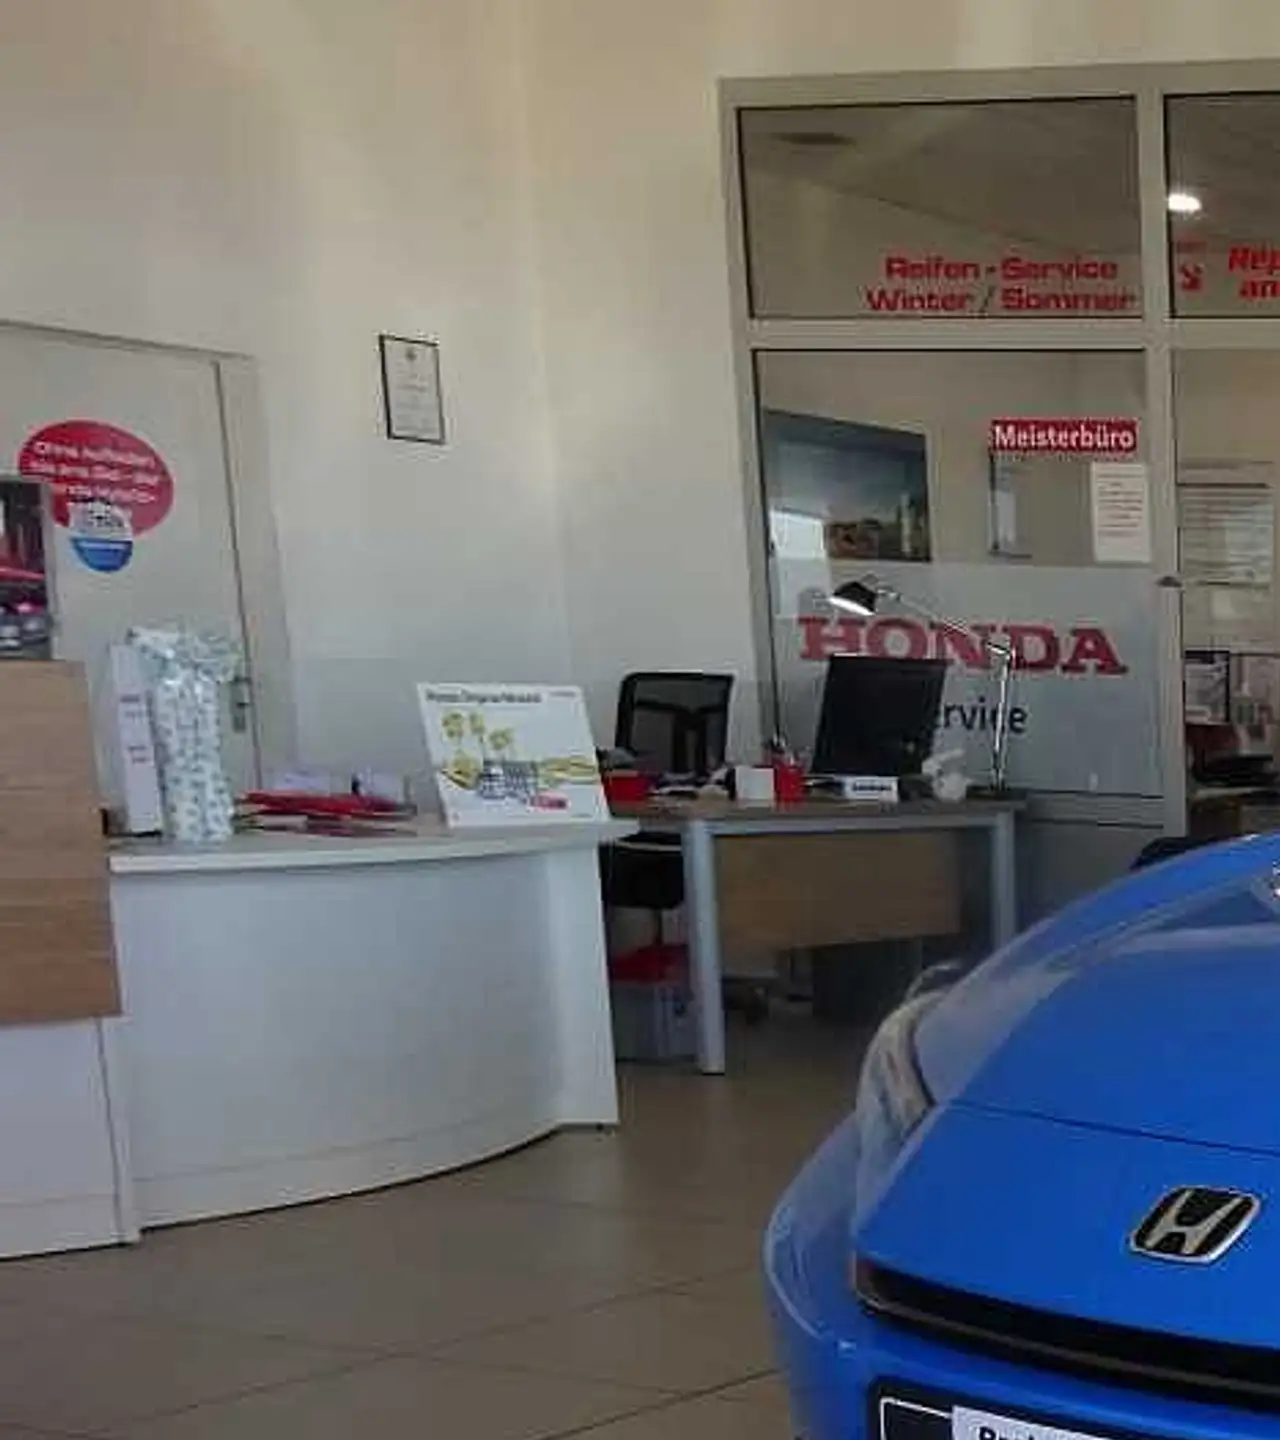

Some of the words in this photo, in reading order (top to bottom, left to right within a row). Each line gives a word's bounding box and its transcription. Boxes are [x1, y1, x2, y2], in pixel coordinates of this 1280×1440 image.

[885, 256, 980, 280] Reifen
[1002, 256, 1119, 280] Service
[866, 288, 971, 311] Winter
[1002, 287, 1137, 311] Sommer
[995, 424, 1135, 448] Meisterbüro
[797, 616, 1129, 675] HONDA
